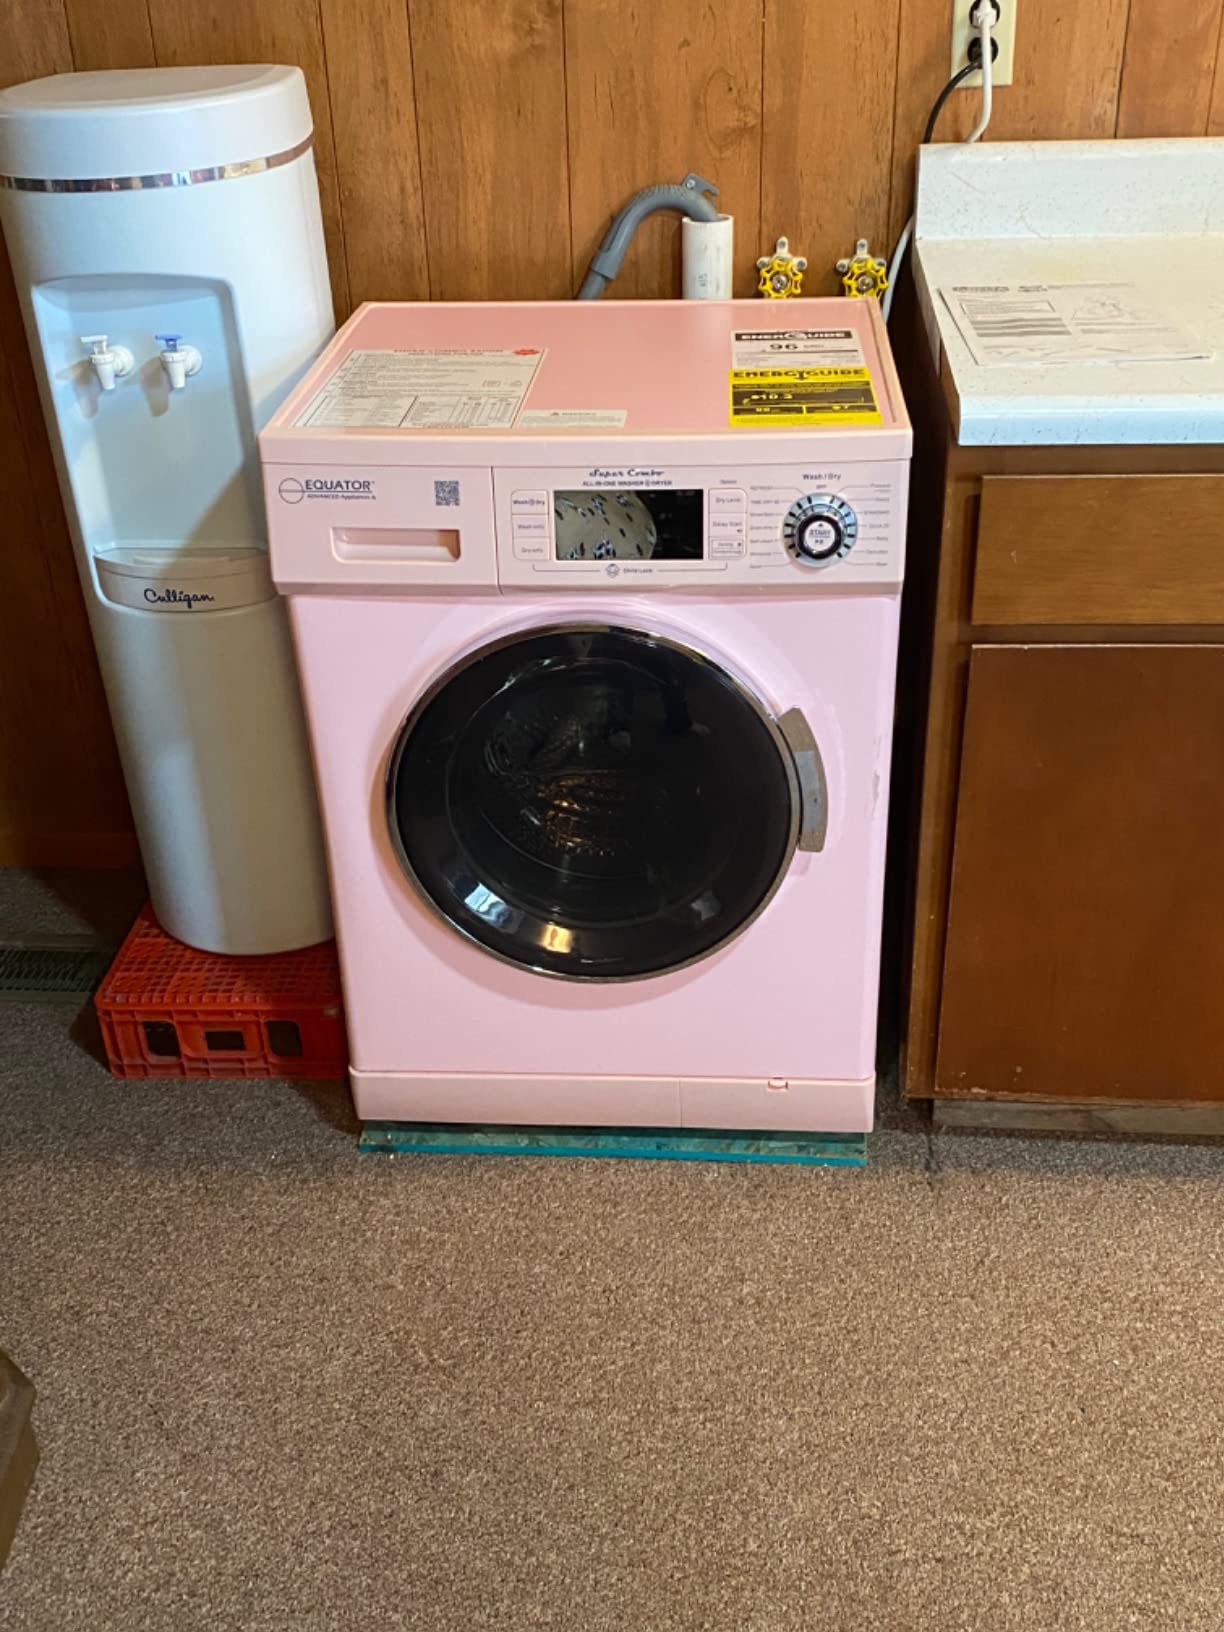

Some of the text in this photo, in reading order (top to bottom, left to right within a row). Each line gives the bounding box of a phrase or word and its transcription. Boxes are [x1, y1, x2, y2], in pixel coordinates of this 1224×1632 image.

[769, 343, 799, 351] 96
[589, 468, 666, 478] Super Combo
[305, 479, 371, 491] EQUATOR
[144, 588, 214, 609] Culligan
